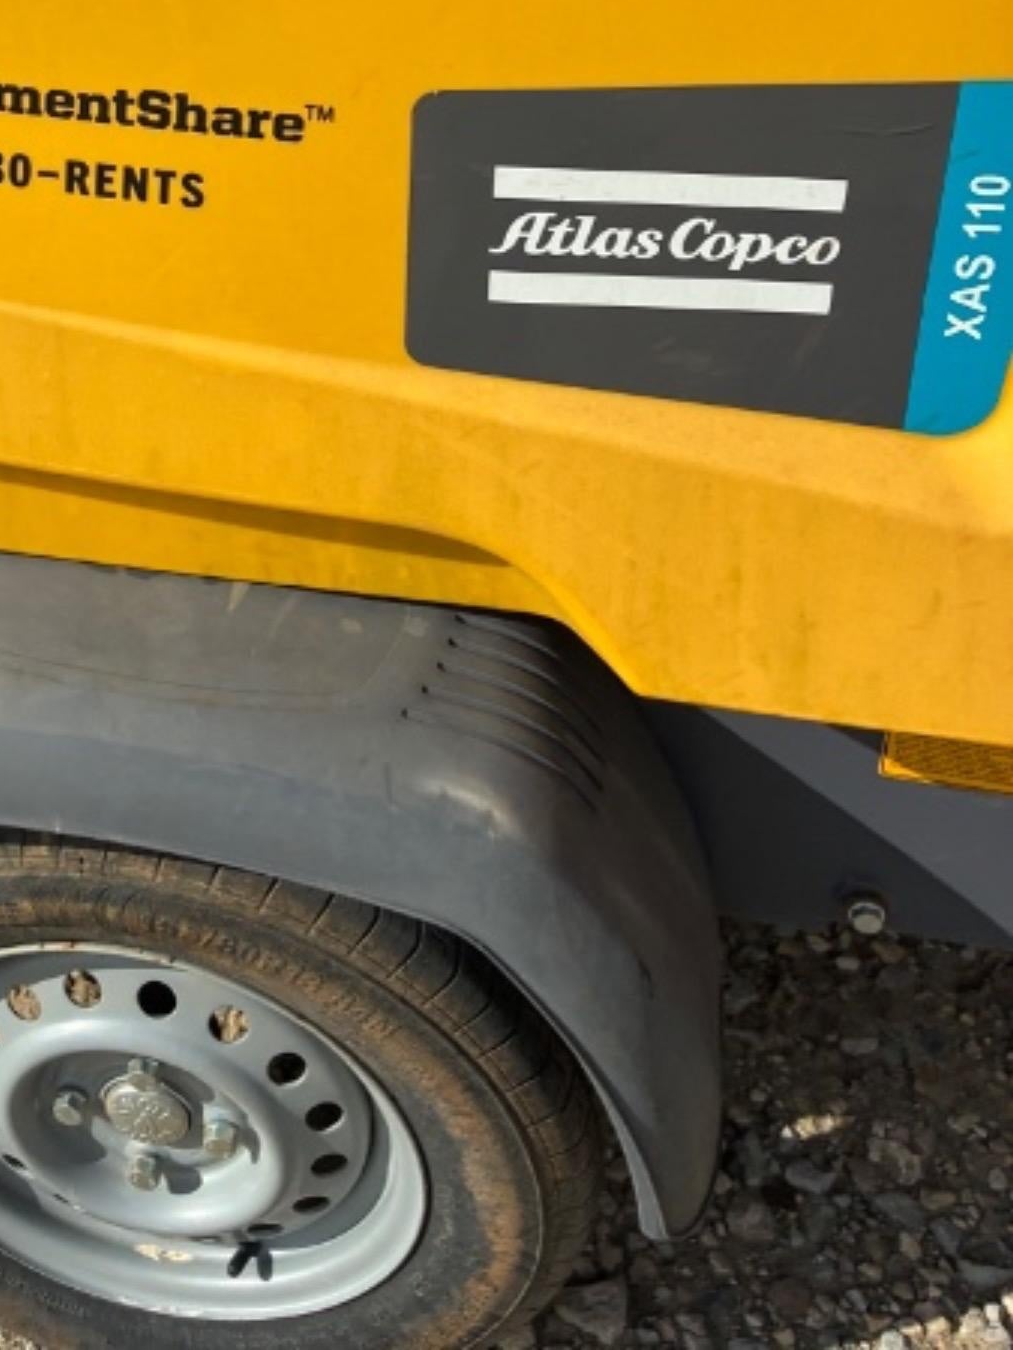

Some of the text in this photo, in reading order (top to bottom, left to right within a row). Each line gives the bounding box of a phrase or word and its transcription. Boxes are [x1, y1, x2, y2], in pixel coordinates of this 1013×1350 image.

[487, 211, 841, 272] Atlas Copco
[942, 174, 1012, 341] XAS 110
